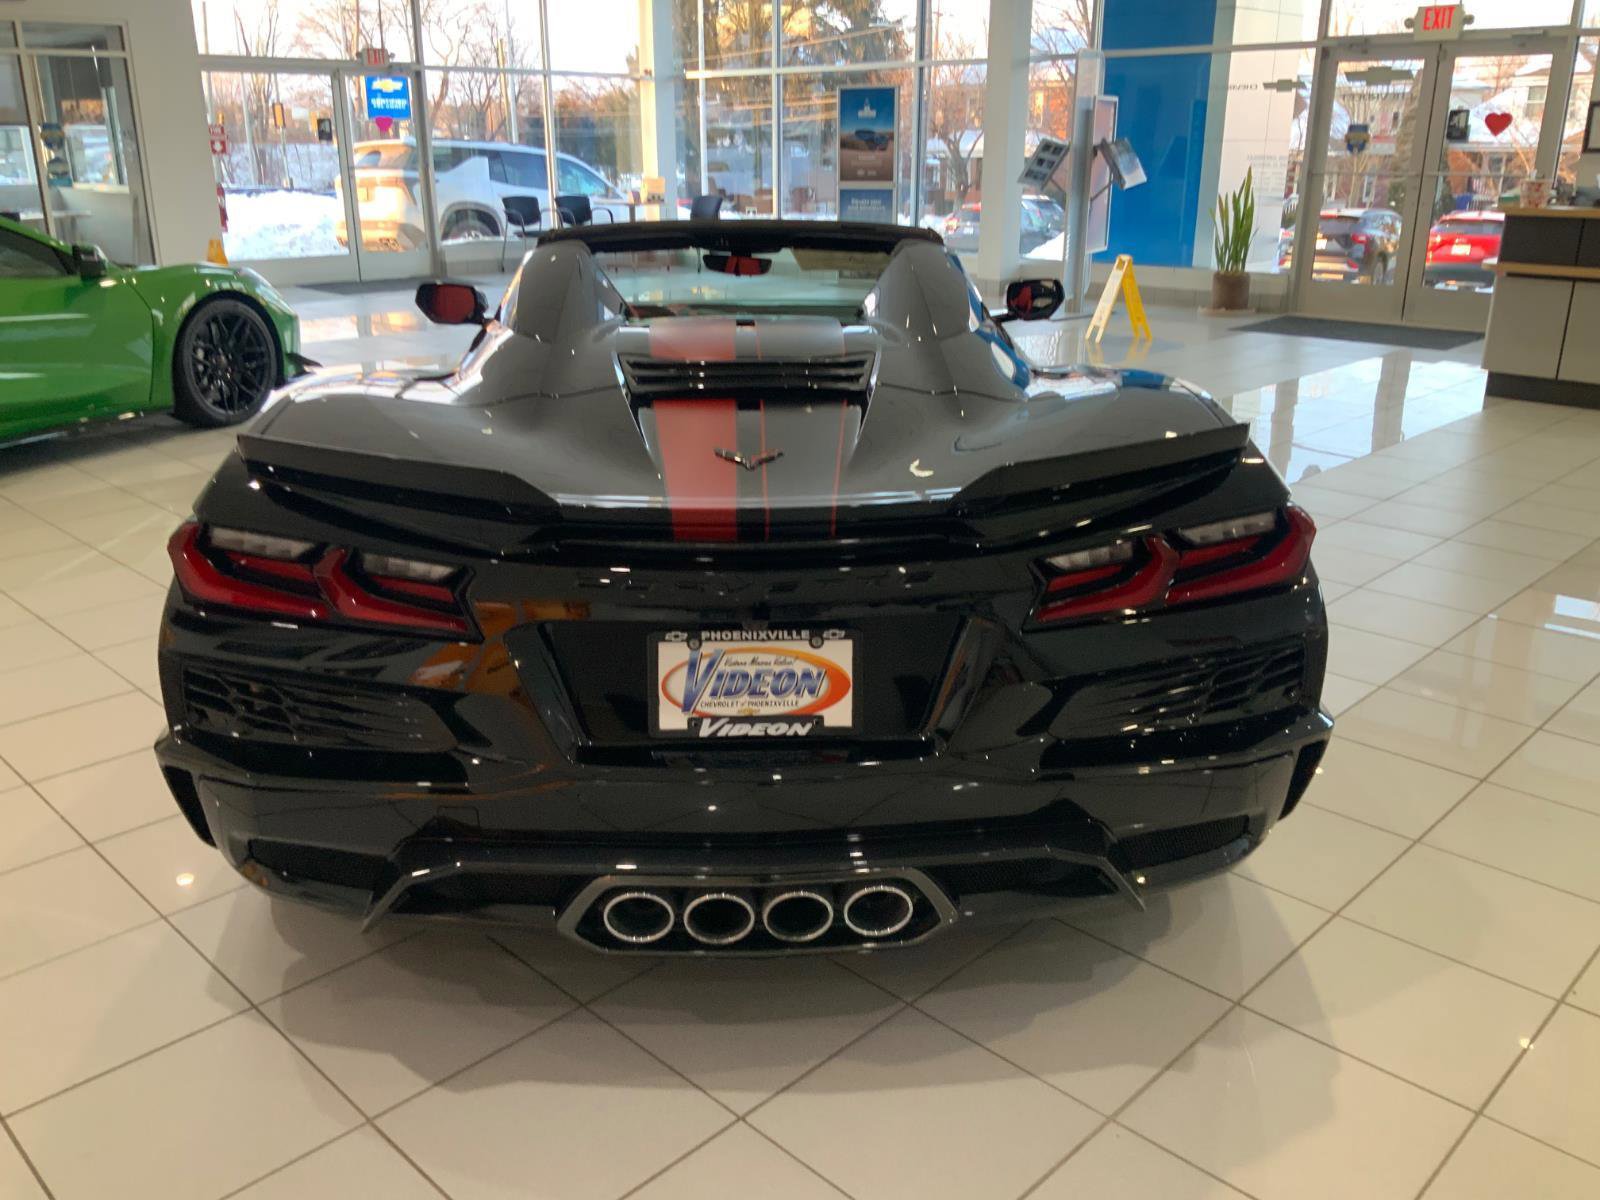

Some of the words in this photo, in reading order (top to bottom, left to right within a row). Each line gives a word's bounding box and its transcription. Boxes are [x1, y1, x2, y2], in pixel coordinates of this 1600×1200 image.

[1423, 5, 1456, 31] EXIT
[701, 630, 811, 641] PHOENIXVILLE
[681, 649, 827, 713] VIDEON
[700, 700, 739, 708] CHEVROLET
[699, 717, 813, 738] VIDEON
